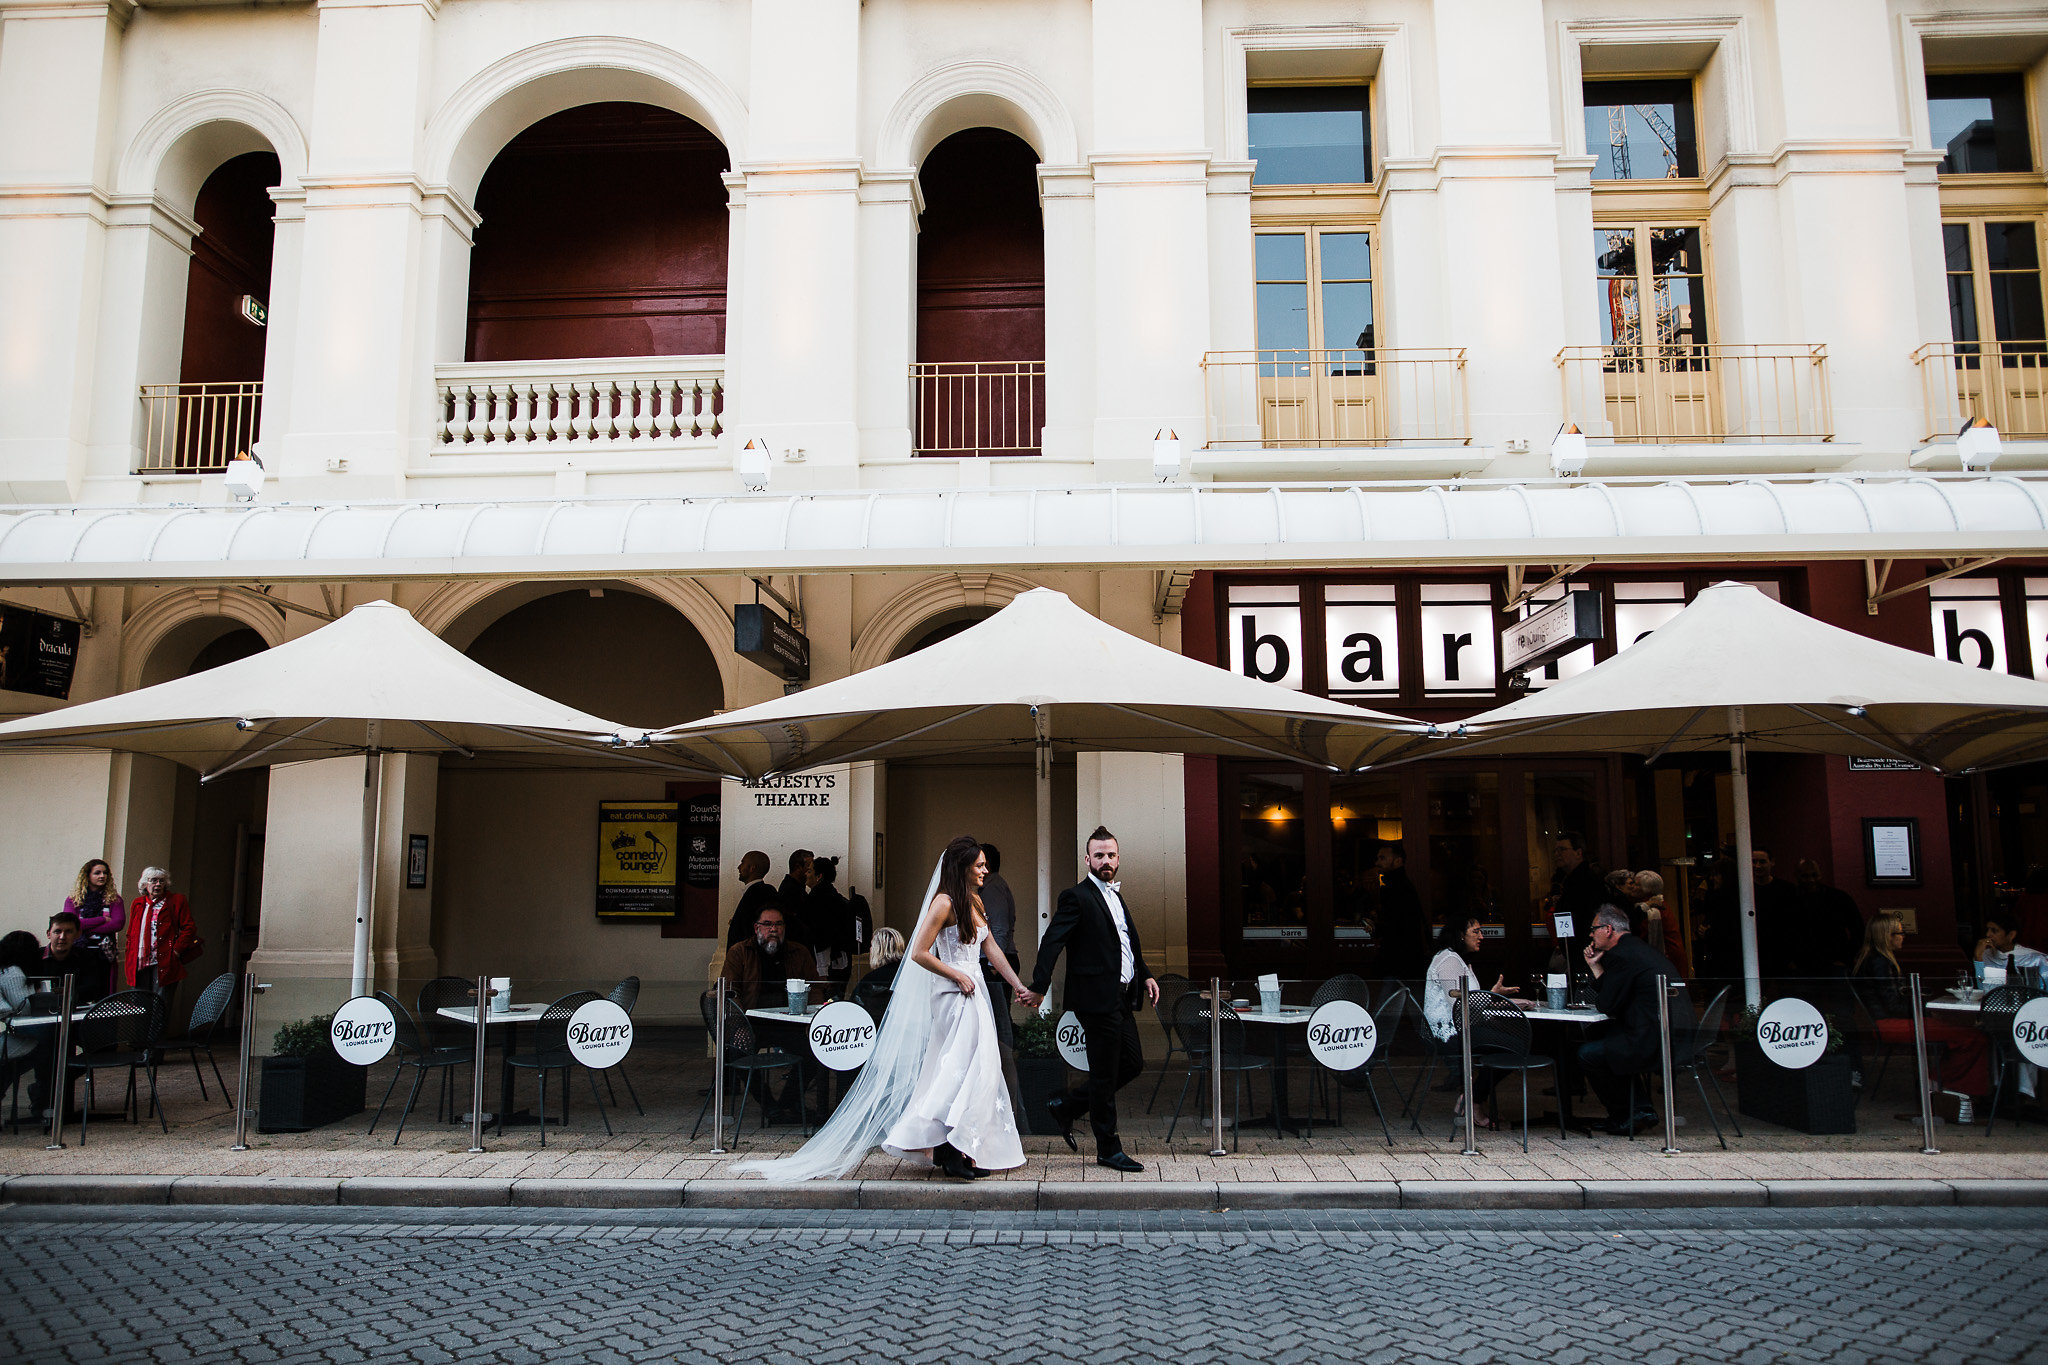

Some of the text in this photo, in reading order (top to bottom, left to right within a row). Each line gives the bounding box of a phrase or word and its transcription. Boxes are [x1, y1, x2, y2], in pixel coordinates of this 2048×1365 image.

[755, 794, 830, 806] THEATRE
[691, 805, 720, 813] DownSt
[625, 812, 645, 820] drink.
[700, 814, 713, 822] the
[616, 851, 663, 863] comedy
[621, 861, 658, 874] lounge
[1560, 920, 1569, 928] 76
[334, 1020, 393, 1041] Barre
[569, 1022, 629, 1044] Barre
[812, 1025, 873, 1046] Barre
[1310, 1024, 1373, 1046] Barre
[1760, 1022, 1823, 1043] Barre
[826, 1044, 848, 1052] LOUNGE
